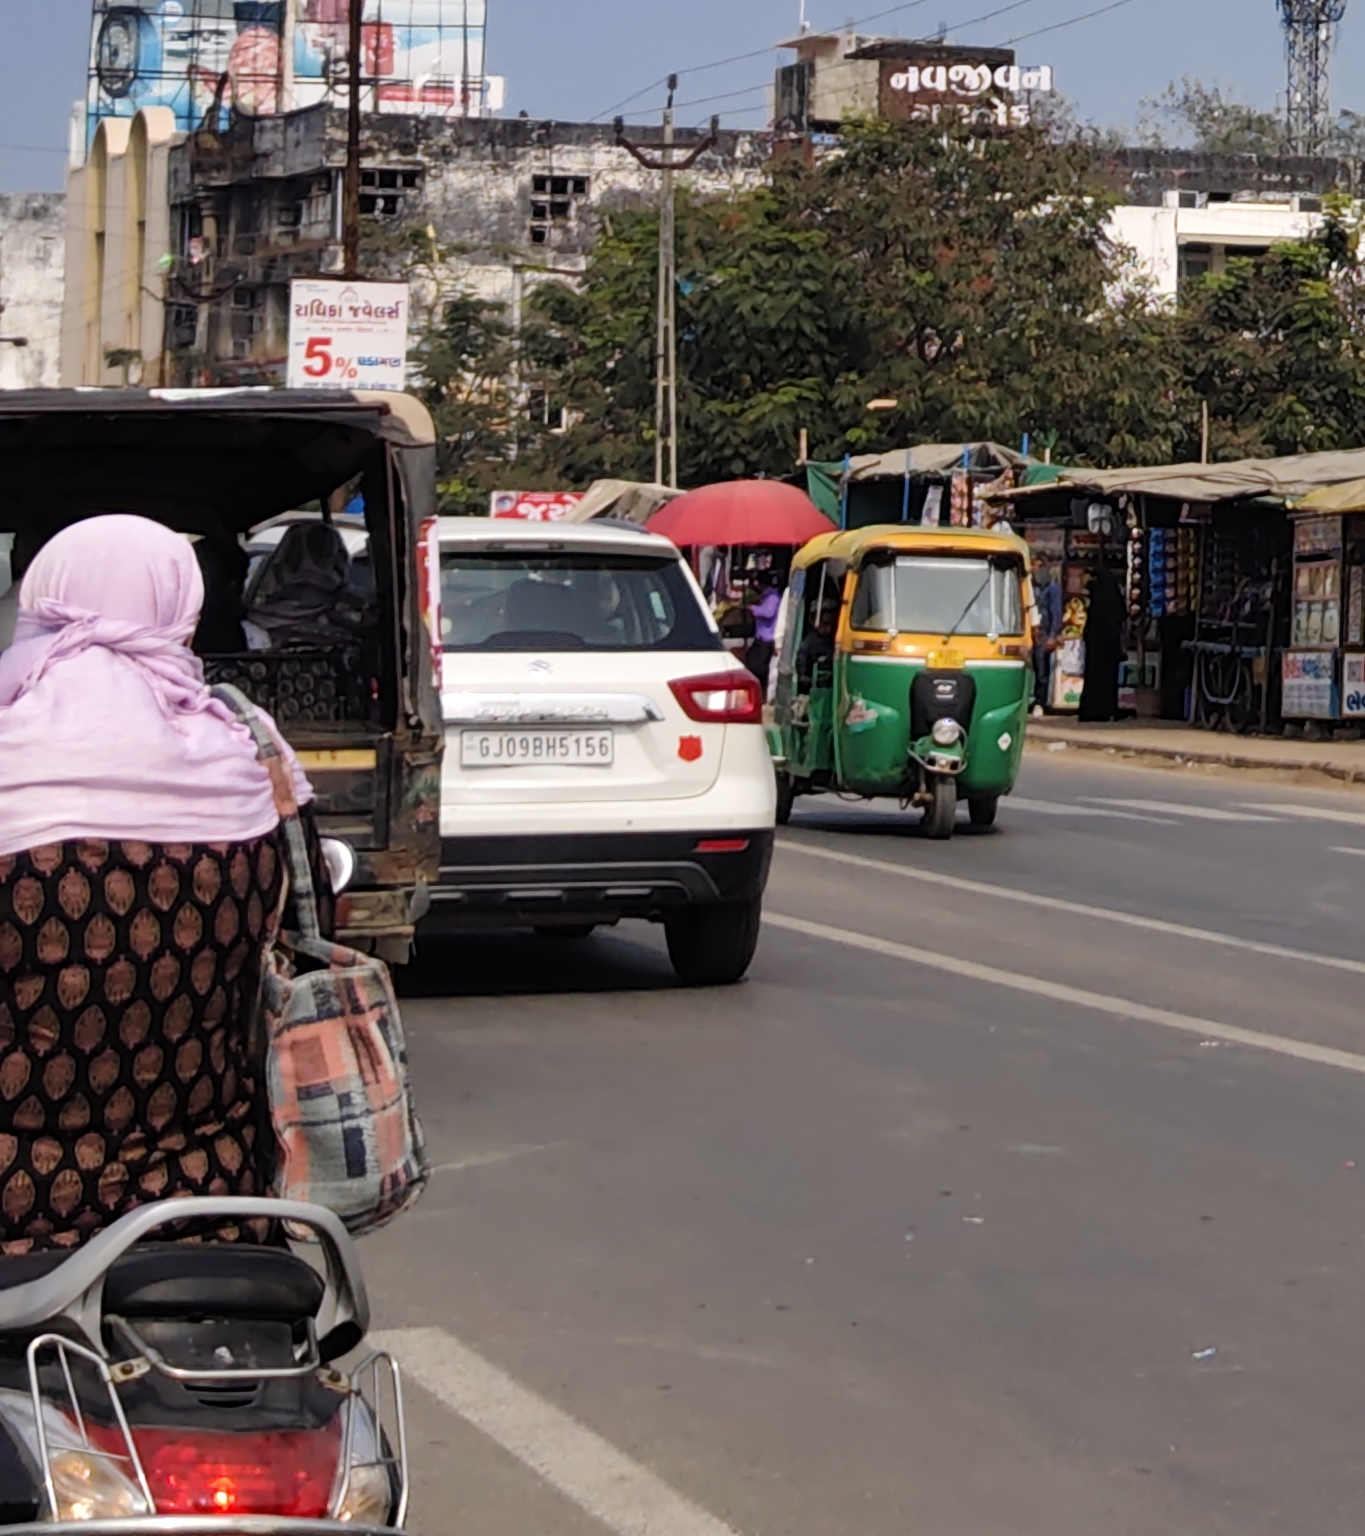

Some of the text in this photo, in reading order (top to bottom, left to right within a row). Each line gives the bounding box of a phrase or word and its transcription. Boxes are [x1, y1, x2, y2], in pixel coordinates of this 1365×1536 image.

[890, 64, 1053, 96] નવજીવન
[295, 298, 343, 318] રાધિકા
[479, 736, 609, 758] GJ09BH5156
